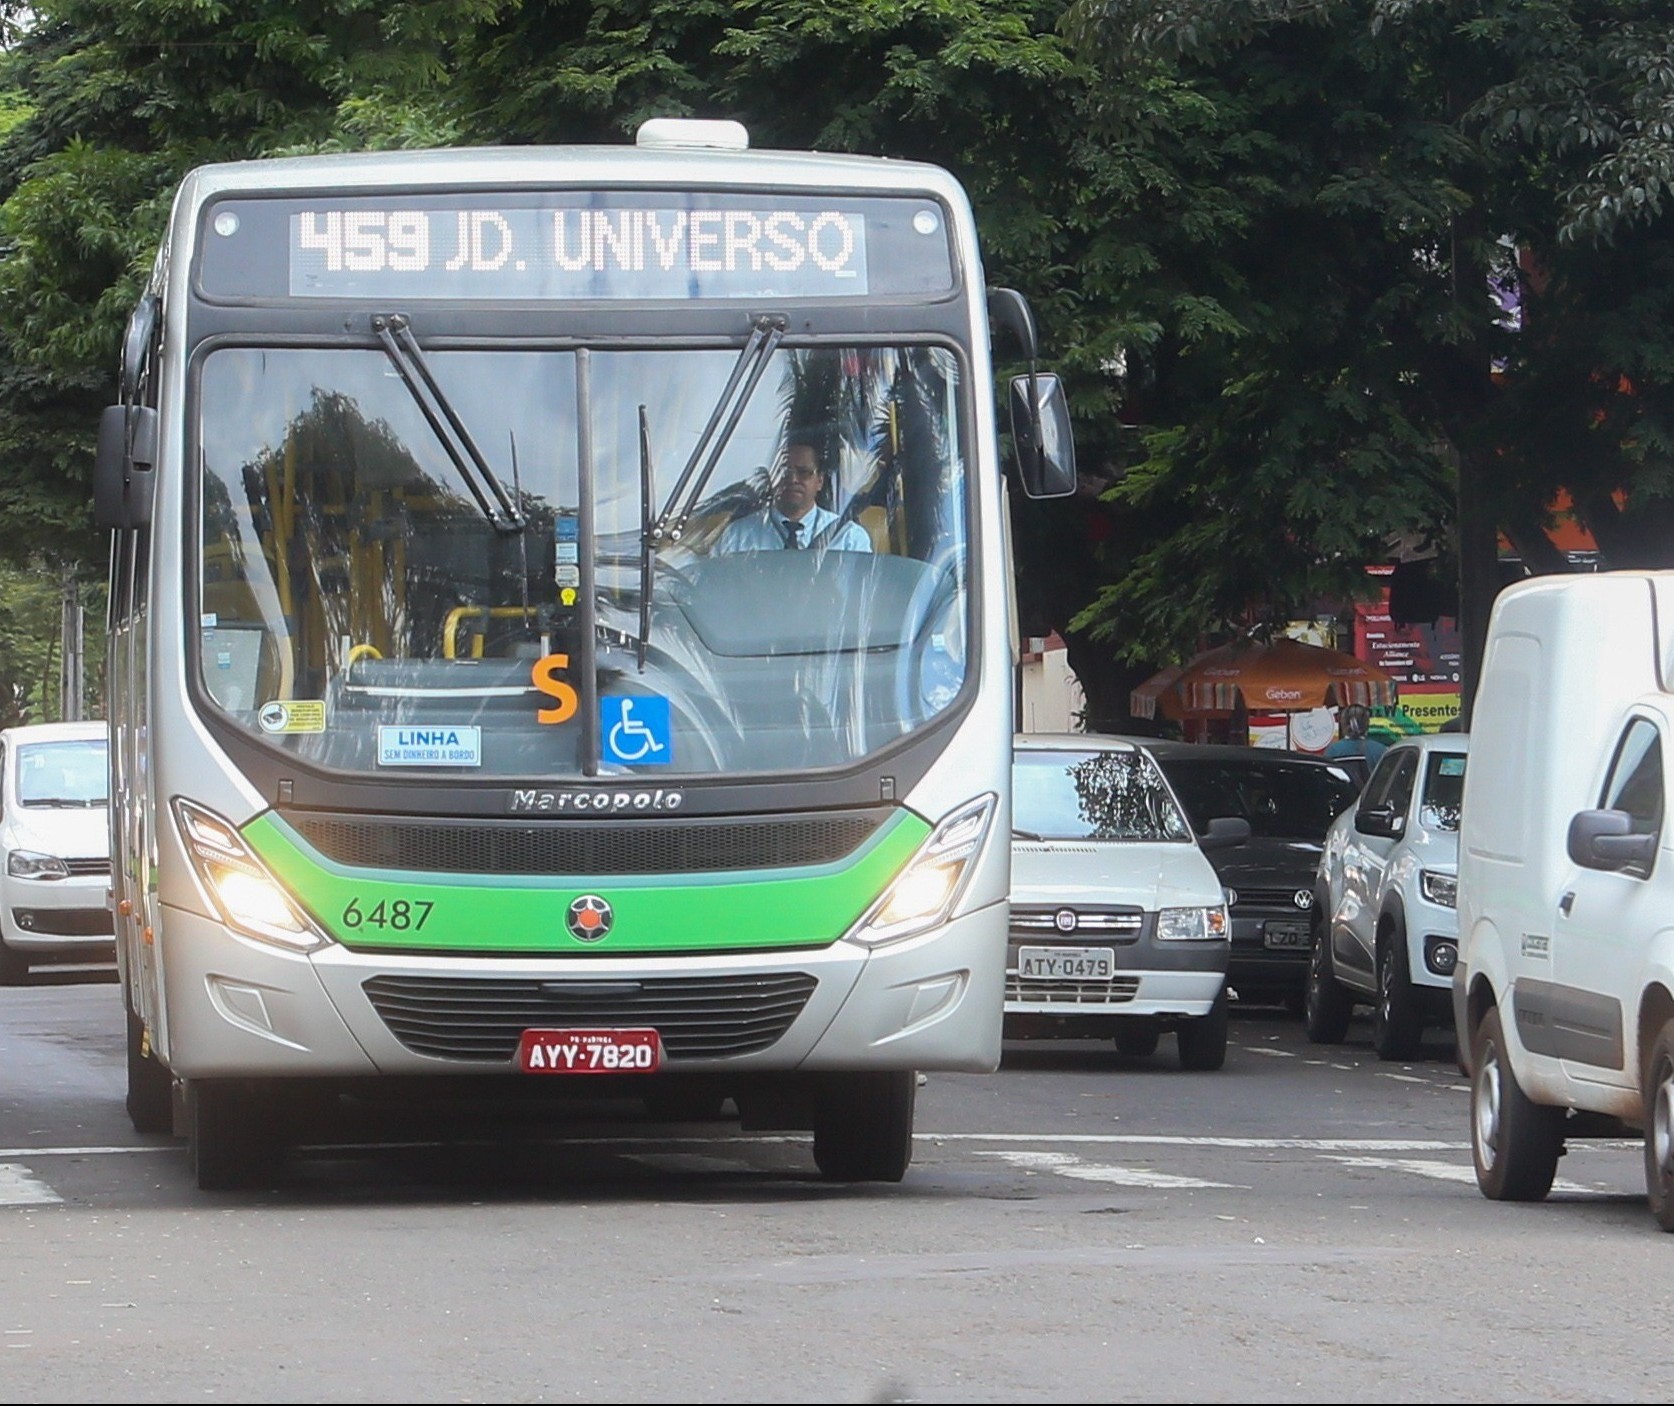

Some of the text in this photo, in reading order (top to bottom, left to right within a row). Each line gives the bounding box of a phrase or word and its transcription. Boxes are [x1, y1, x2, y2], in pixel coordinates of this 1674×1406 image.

[300, 210, 854, 272] 459 JD. UNIVERSO
[531, 654, 577, 724] S
[398, 730, 460, 746] LINHA
[384, 749, 475, 760] SEM DINHEIRO A BORDO
[510, 788, 683, 814] Marcopolo
[342, 896, 435, 931] 6487
